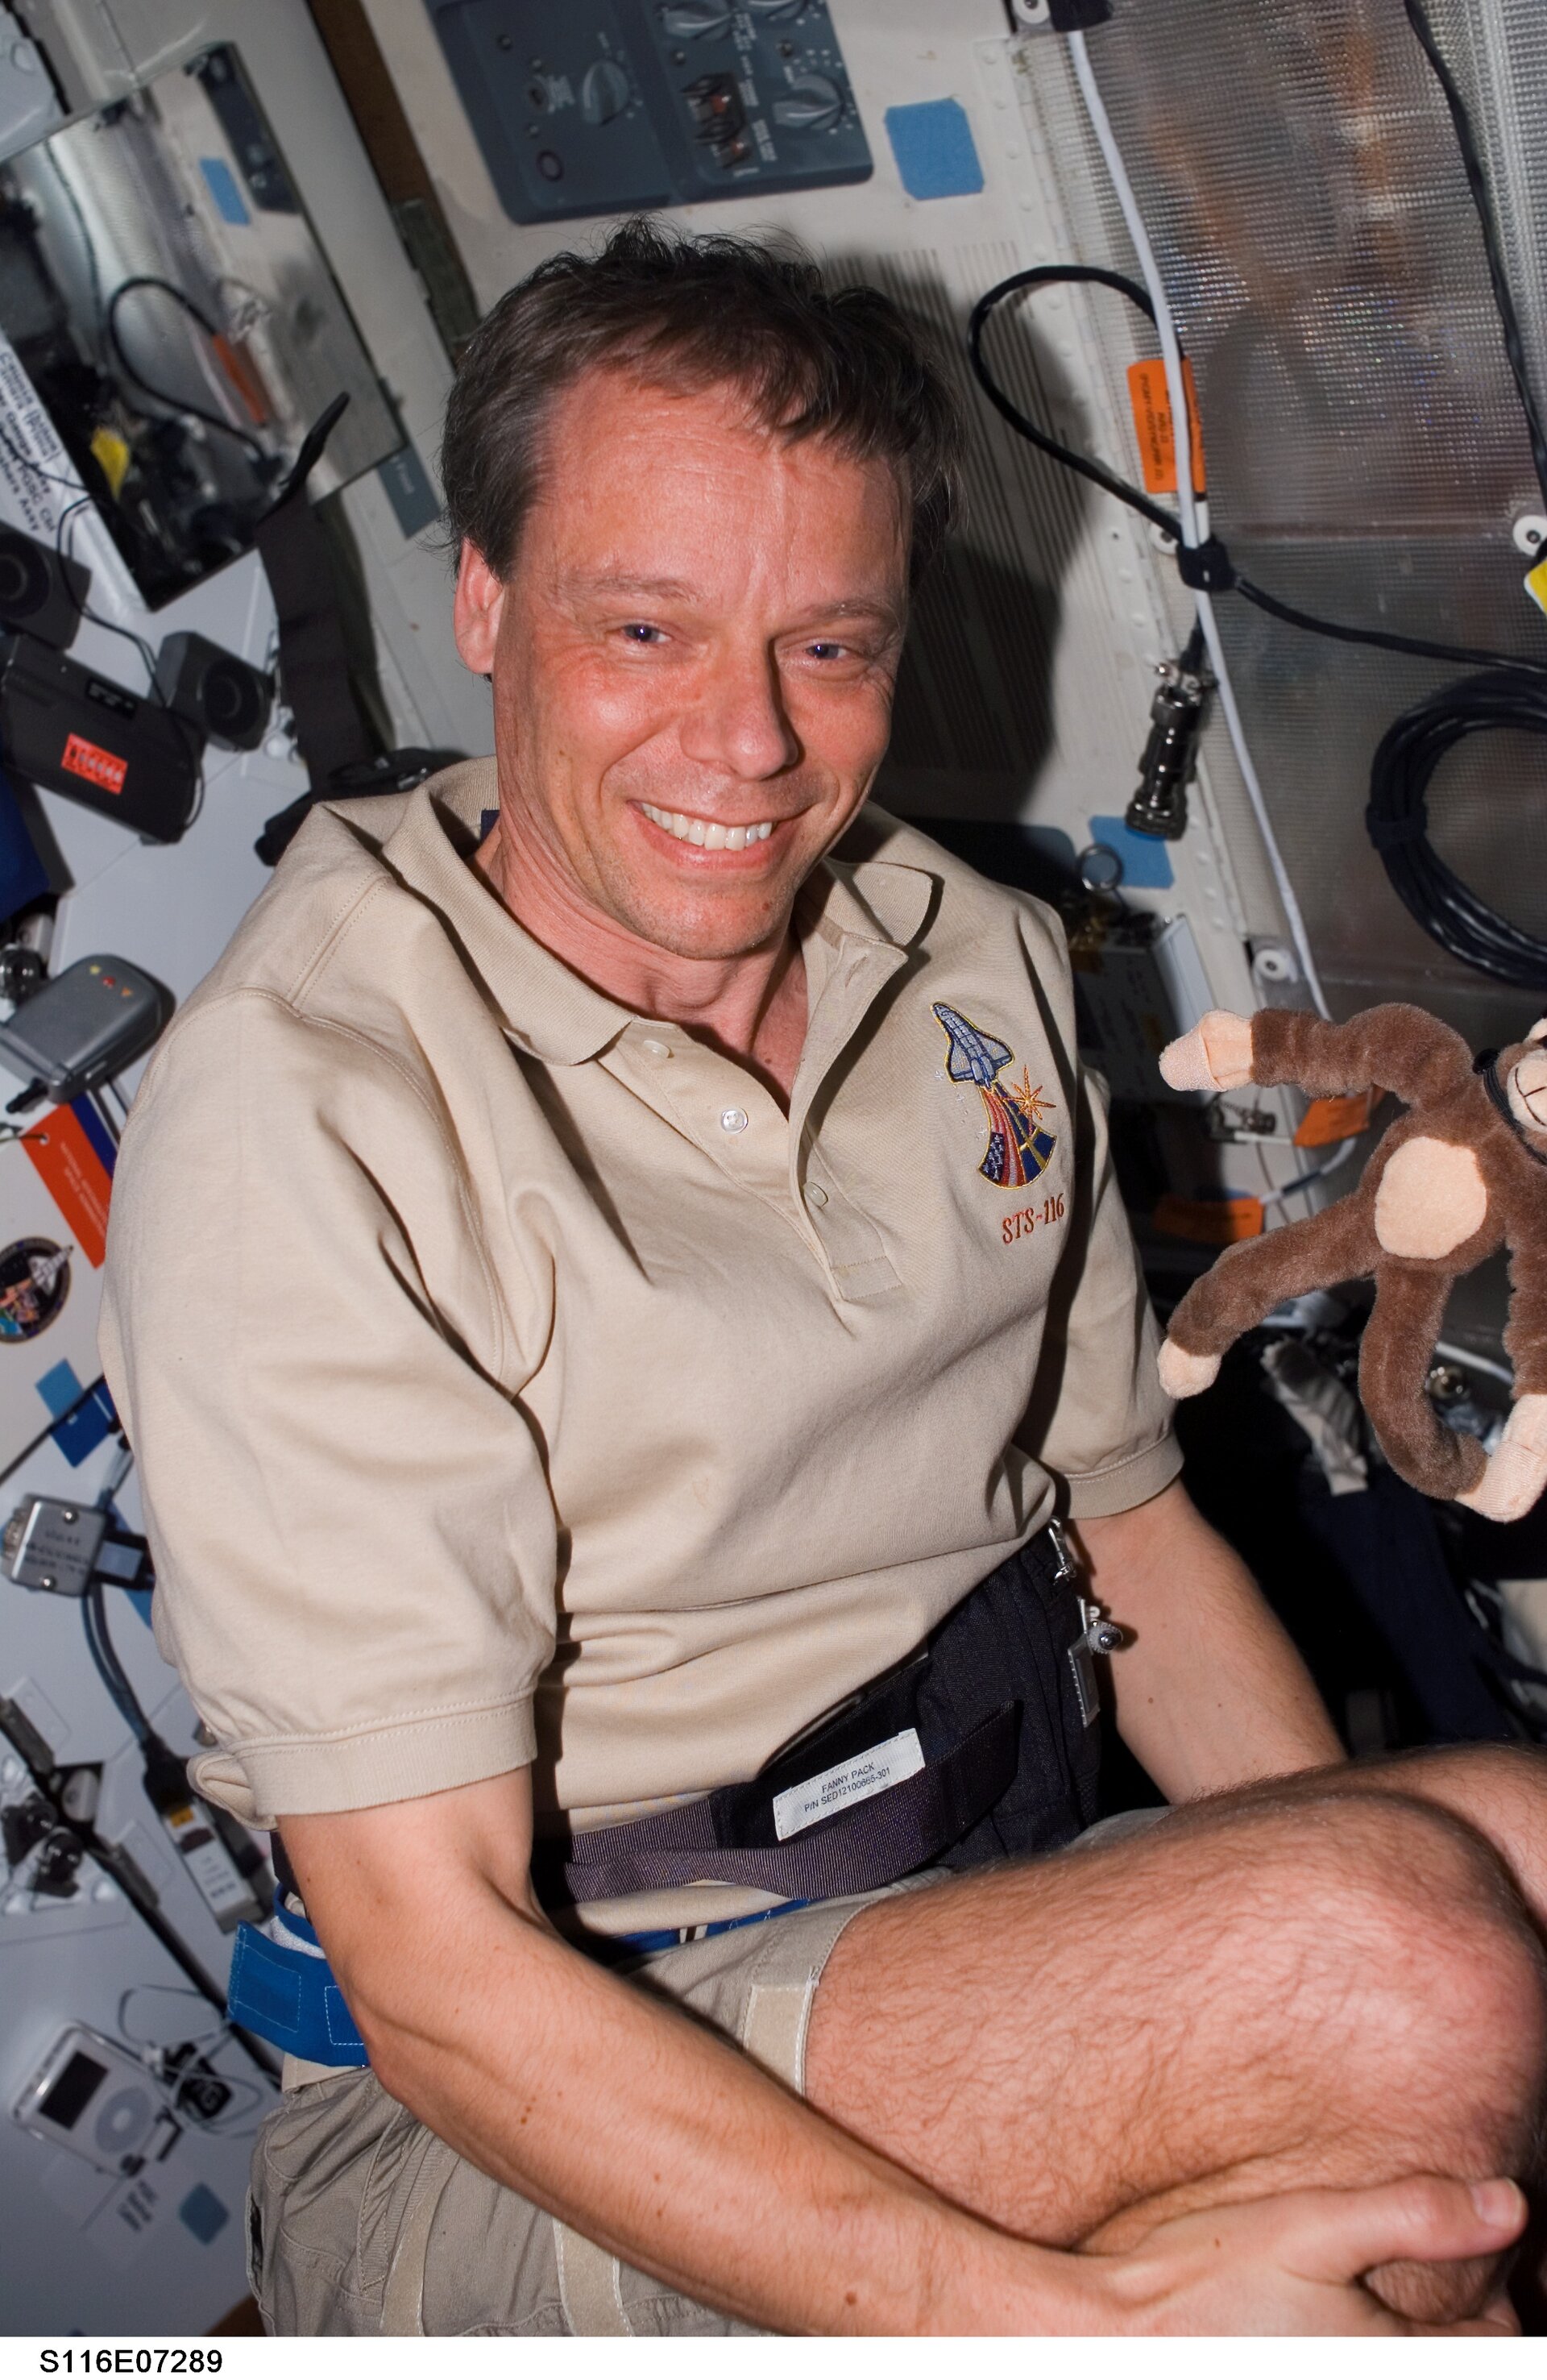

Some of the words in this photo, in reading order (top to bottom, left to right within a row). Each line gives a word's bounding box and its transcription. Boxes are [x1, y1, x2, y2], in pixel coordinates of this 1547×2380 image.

[1002, 1193, 1064, 1244] STS-116
[822, 1774, 848, 1793] FANNY
[851, 1762, 875, 1779] PACK
[804, 1800, 819, 1813] P/N
